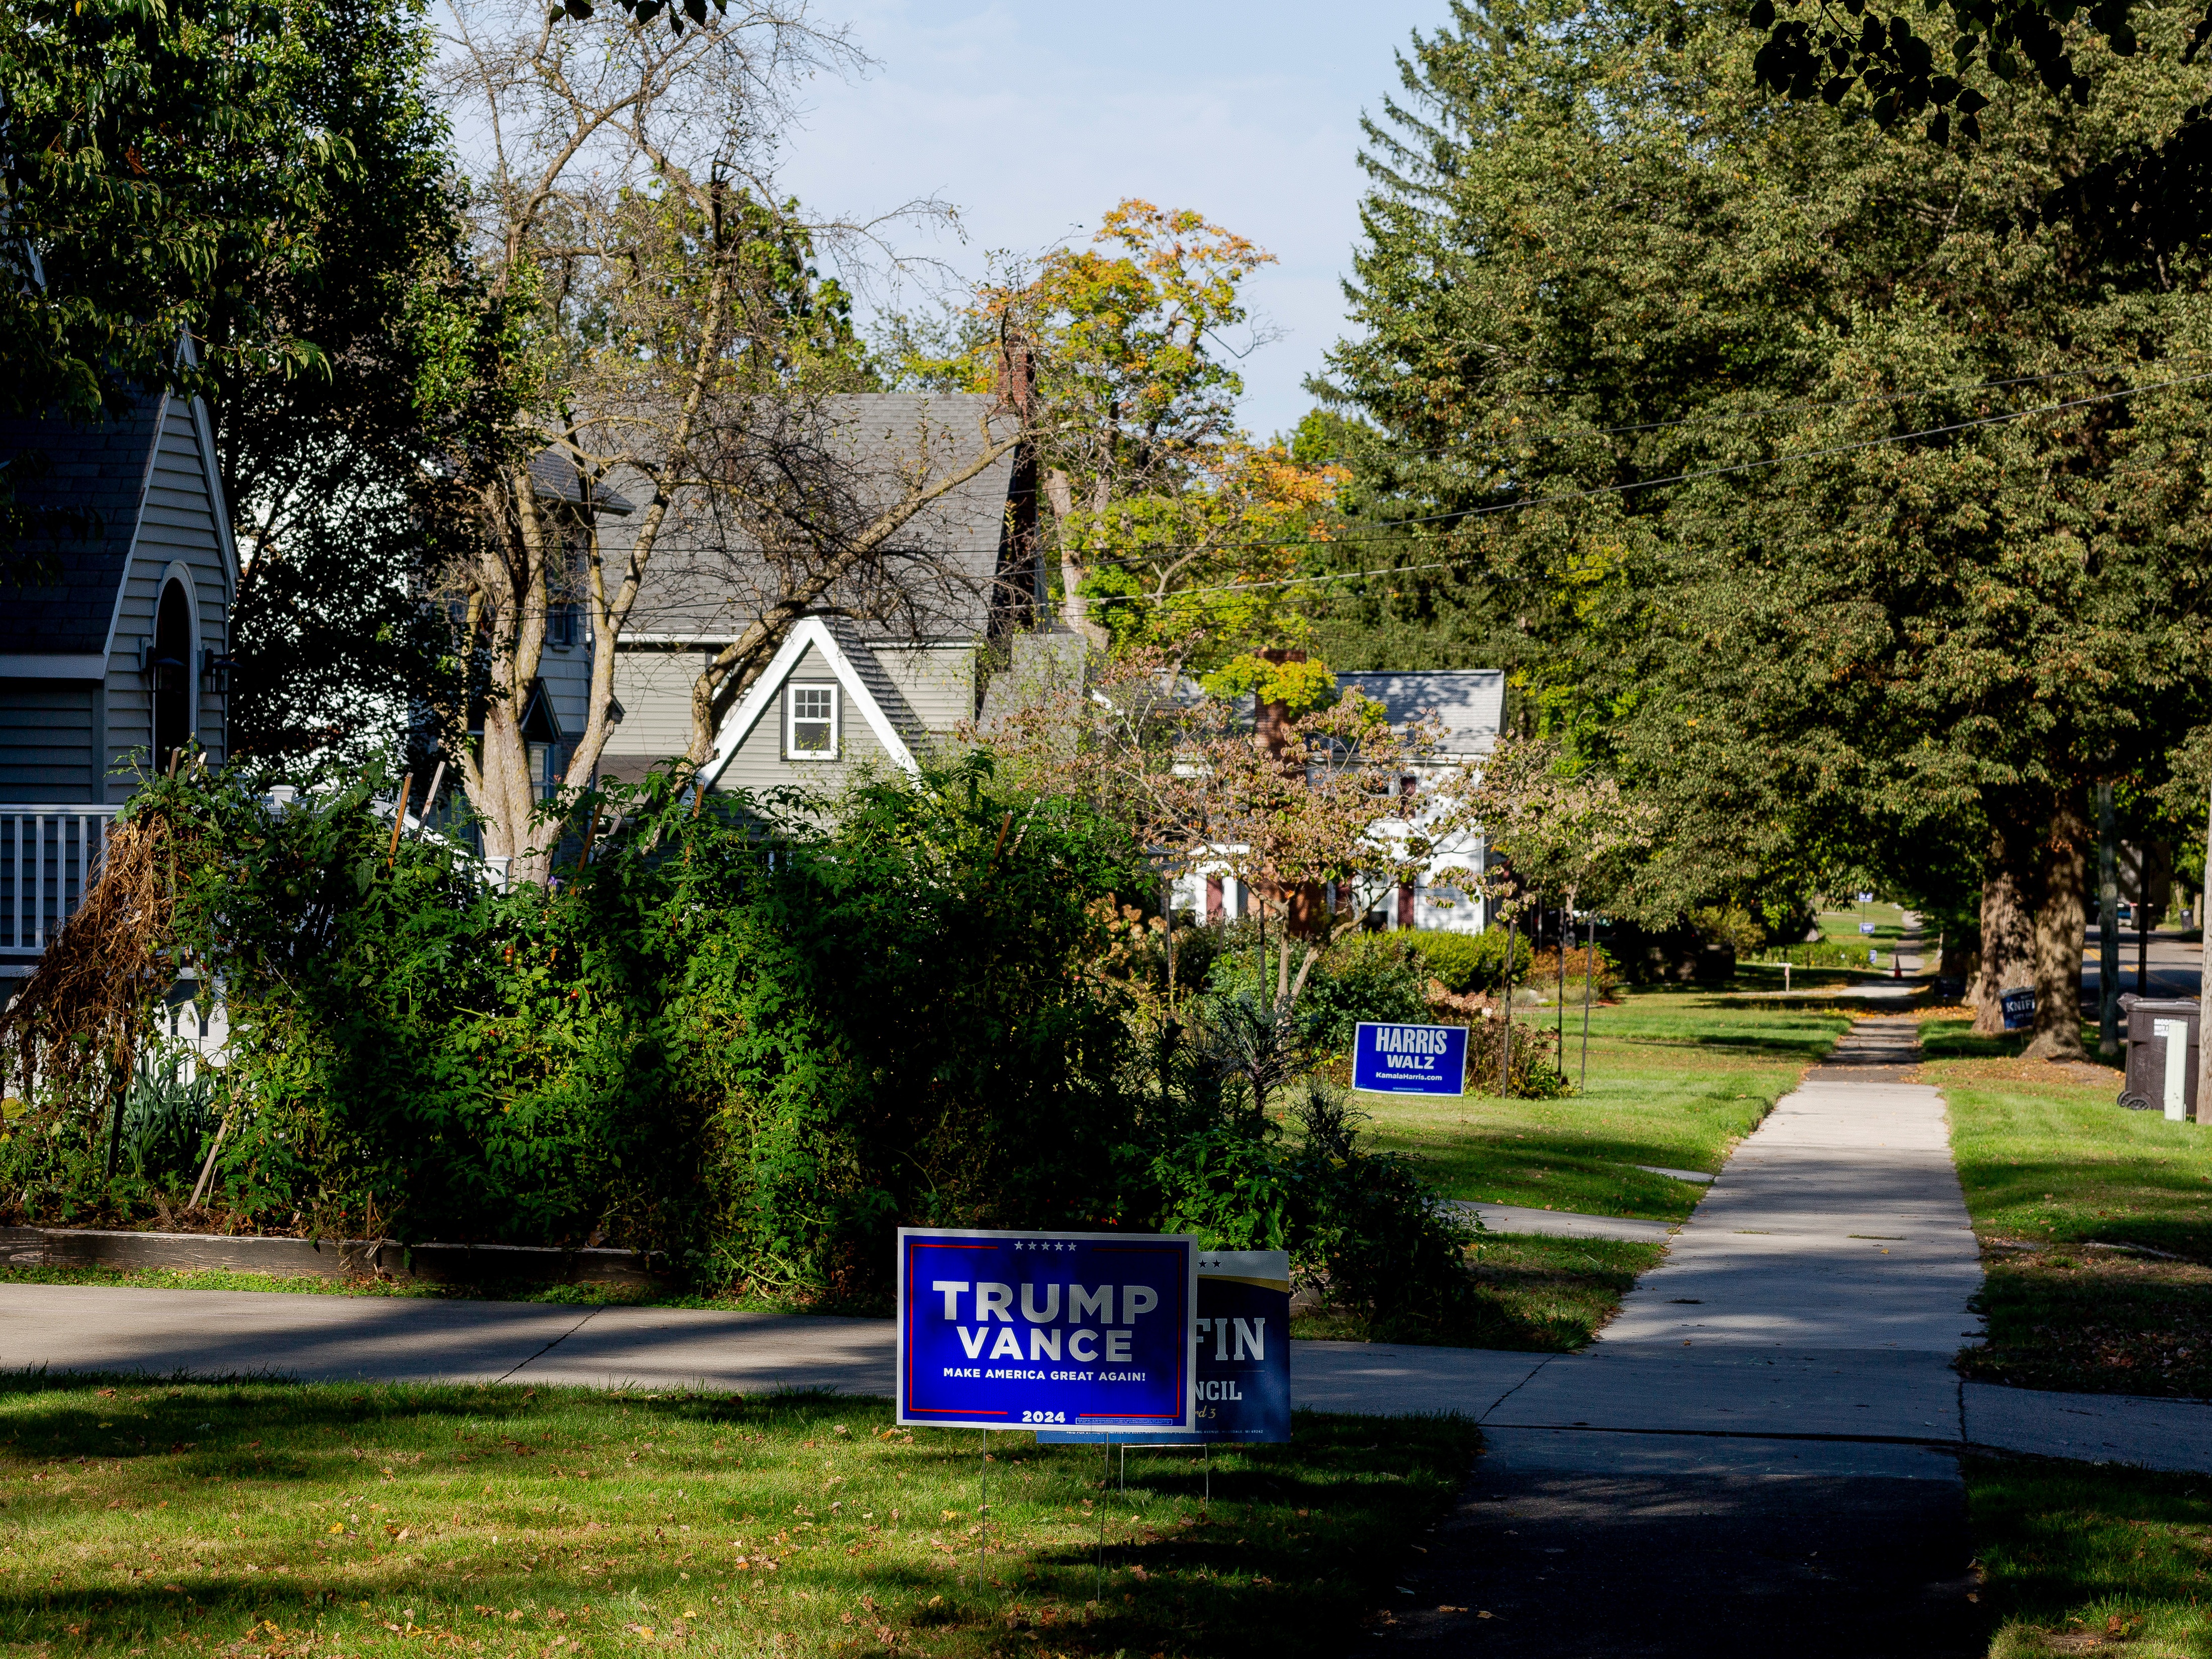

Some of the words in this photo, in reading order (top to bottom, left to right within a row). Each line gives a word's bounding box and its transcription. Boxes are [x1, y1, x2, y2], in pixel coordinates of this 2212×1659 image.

[1375, 1027, 1447, 1055] HARRIS
[1387, 1055, 1435, 1069] WALZ
[1376, 1072, 1442, 1081] KamalaHarris.com
[933, 1281, 1158, 1324] TRUMP
[956, 1326, 1132, 1362] VANCE
[944, 1368, 981, 1377] MAKE
[985, 1369, 1045, 1380] AMERICA
[1050, 1371, 1094, 1380] GREAT
[1099, 1372, 1145, 1381] AGAIN!
[1022, 1411, 1066, 1423] 2024
[1208, 1409, 1216, 1419] 3
